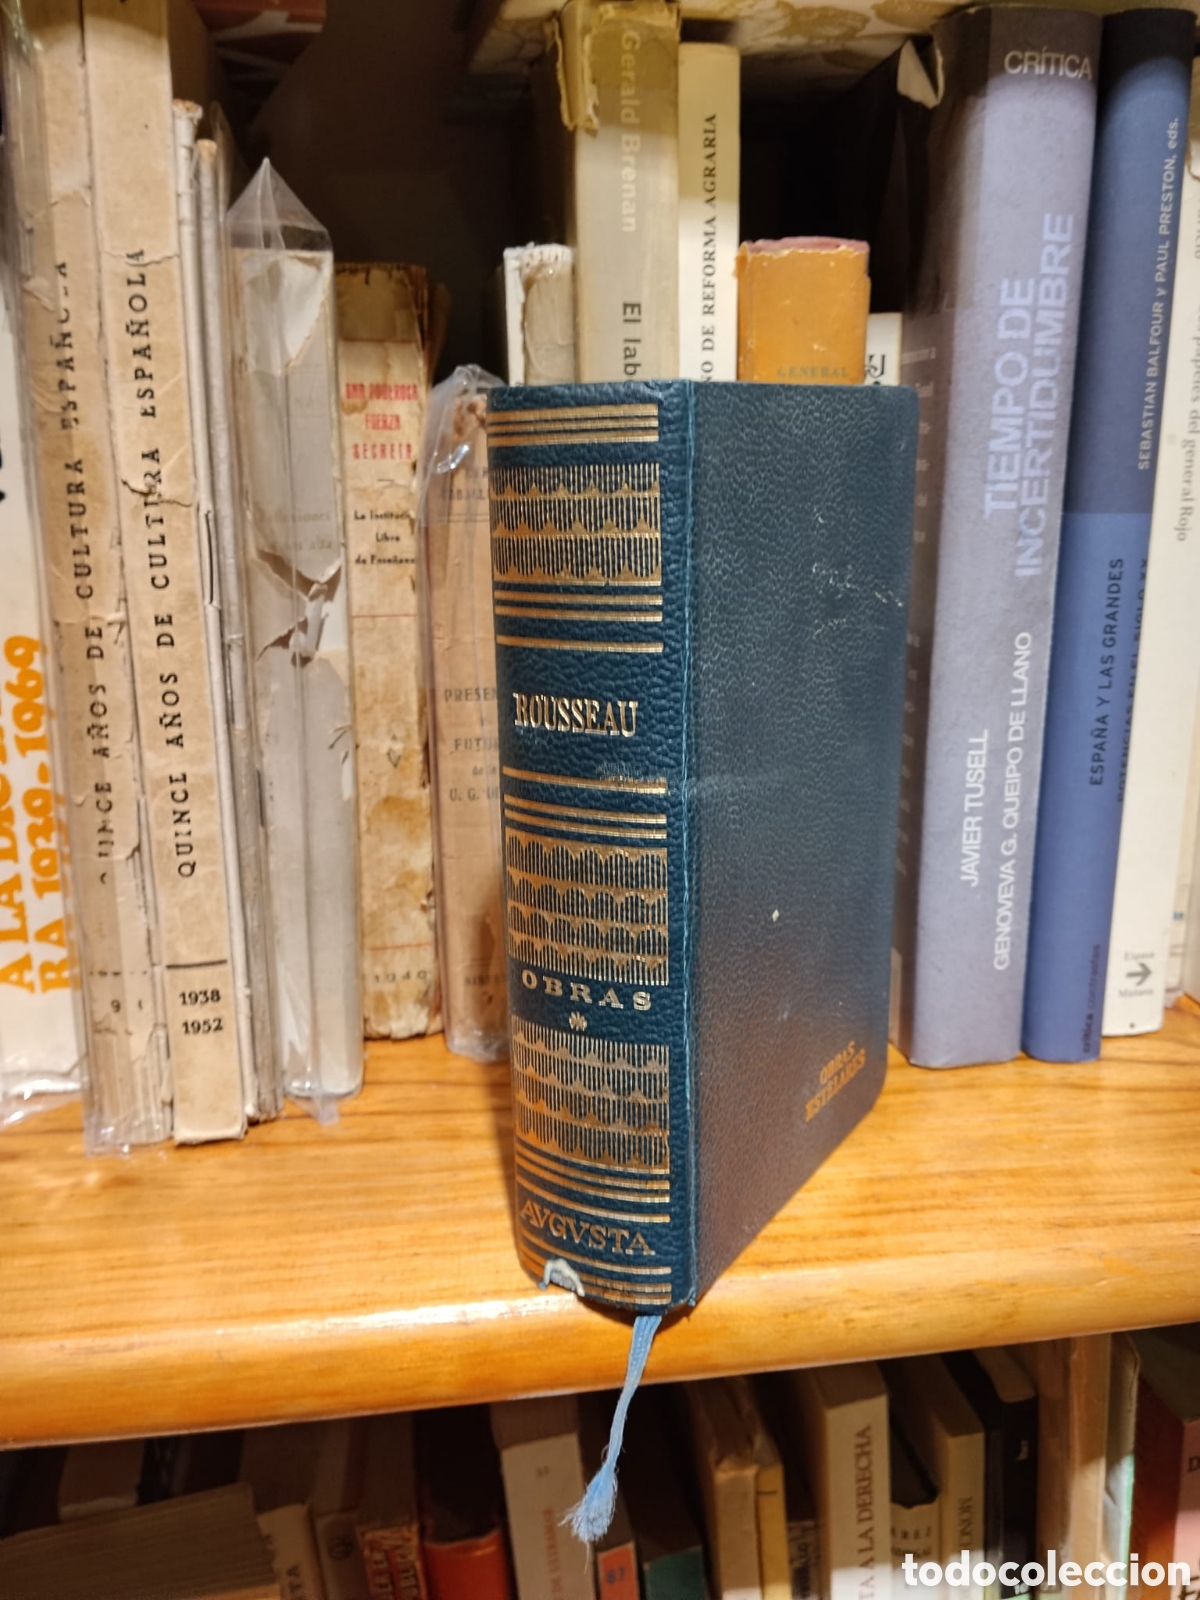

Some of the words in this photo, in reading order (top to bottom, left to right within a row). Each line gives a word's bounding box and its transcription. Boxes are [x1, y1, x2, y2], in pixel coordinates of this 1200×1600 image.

[620, 29, 641, 126] Gerald
[1004, 47, 1092, 80] CRÍTICA
[620, 134, 641, 233] Brenan
[702, 113, 718, 209] AGRARIA
[701, 216, 717, 317] REFORMA
[1155, 240, 1170, 283] PAUL
[125, 249, 157, 418] ESPAÑOLA
[622, 302, 642, 324] El
[701, 324, 715, 352] DE
[997, 277, 1036, 341] DE
[1146, 302, 1164, 377] BALFOUR
[50, 261, 79, 431] ESPAÑA
[622, 338, 642, 381] lab
[776, 365, 850, 379] GENERAL
[1015, 213, 1074, 578] INCERTIDUMBRE
[1138, 380, 1158, 470] SEBASTIAN
[984, 352, 1029, 519] TIEMPO
[1180, 439, 1196, 501] general
[65, 458, 94, 599] CULTURA
[1173, 506, 1194, 542] Rojo
[154, 613, 175, 648] DE
[1102, 557, 1124, 649] GRANDES
[85, 625, 104, 660] DE
[1011, 631, 1032, 707] LLANO
[1100, 655, 1115, 690] LAS
[87, 683, 111, 759] AÑOS
[159, 672, 184, 748] AÑOS
[513, 692, 638, 738] ROUSSEAU
[1008, 710, 1026, 742] DE
[1097, 697, 1110, 709] Y
[964, 729, 988, 812] TUSELL
[1089, 714, 1110, 786] ESPAÑA
[1003, 746, 1023, 830] QUEIPO
[169, 772, 197, 878] QUINCE
[960, 816, 983, 888] JAVIER
[1001, 832, 1018, 857] G.
[994, 858, 1017, 971] GENOVEVA
[180, 989, 221, 1006] 1938
[521, 968, 652, 1011] OBRAS
[182, 1017, 223, 1035] 1952
[519, 1199, 656, 1256] AVGVSTA
[854, 1424, 875, 1523] DERECHA
[857, 1526, 875, 1559] LA
